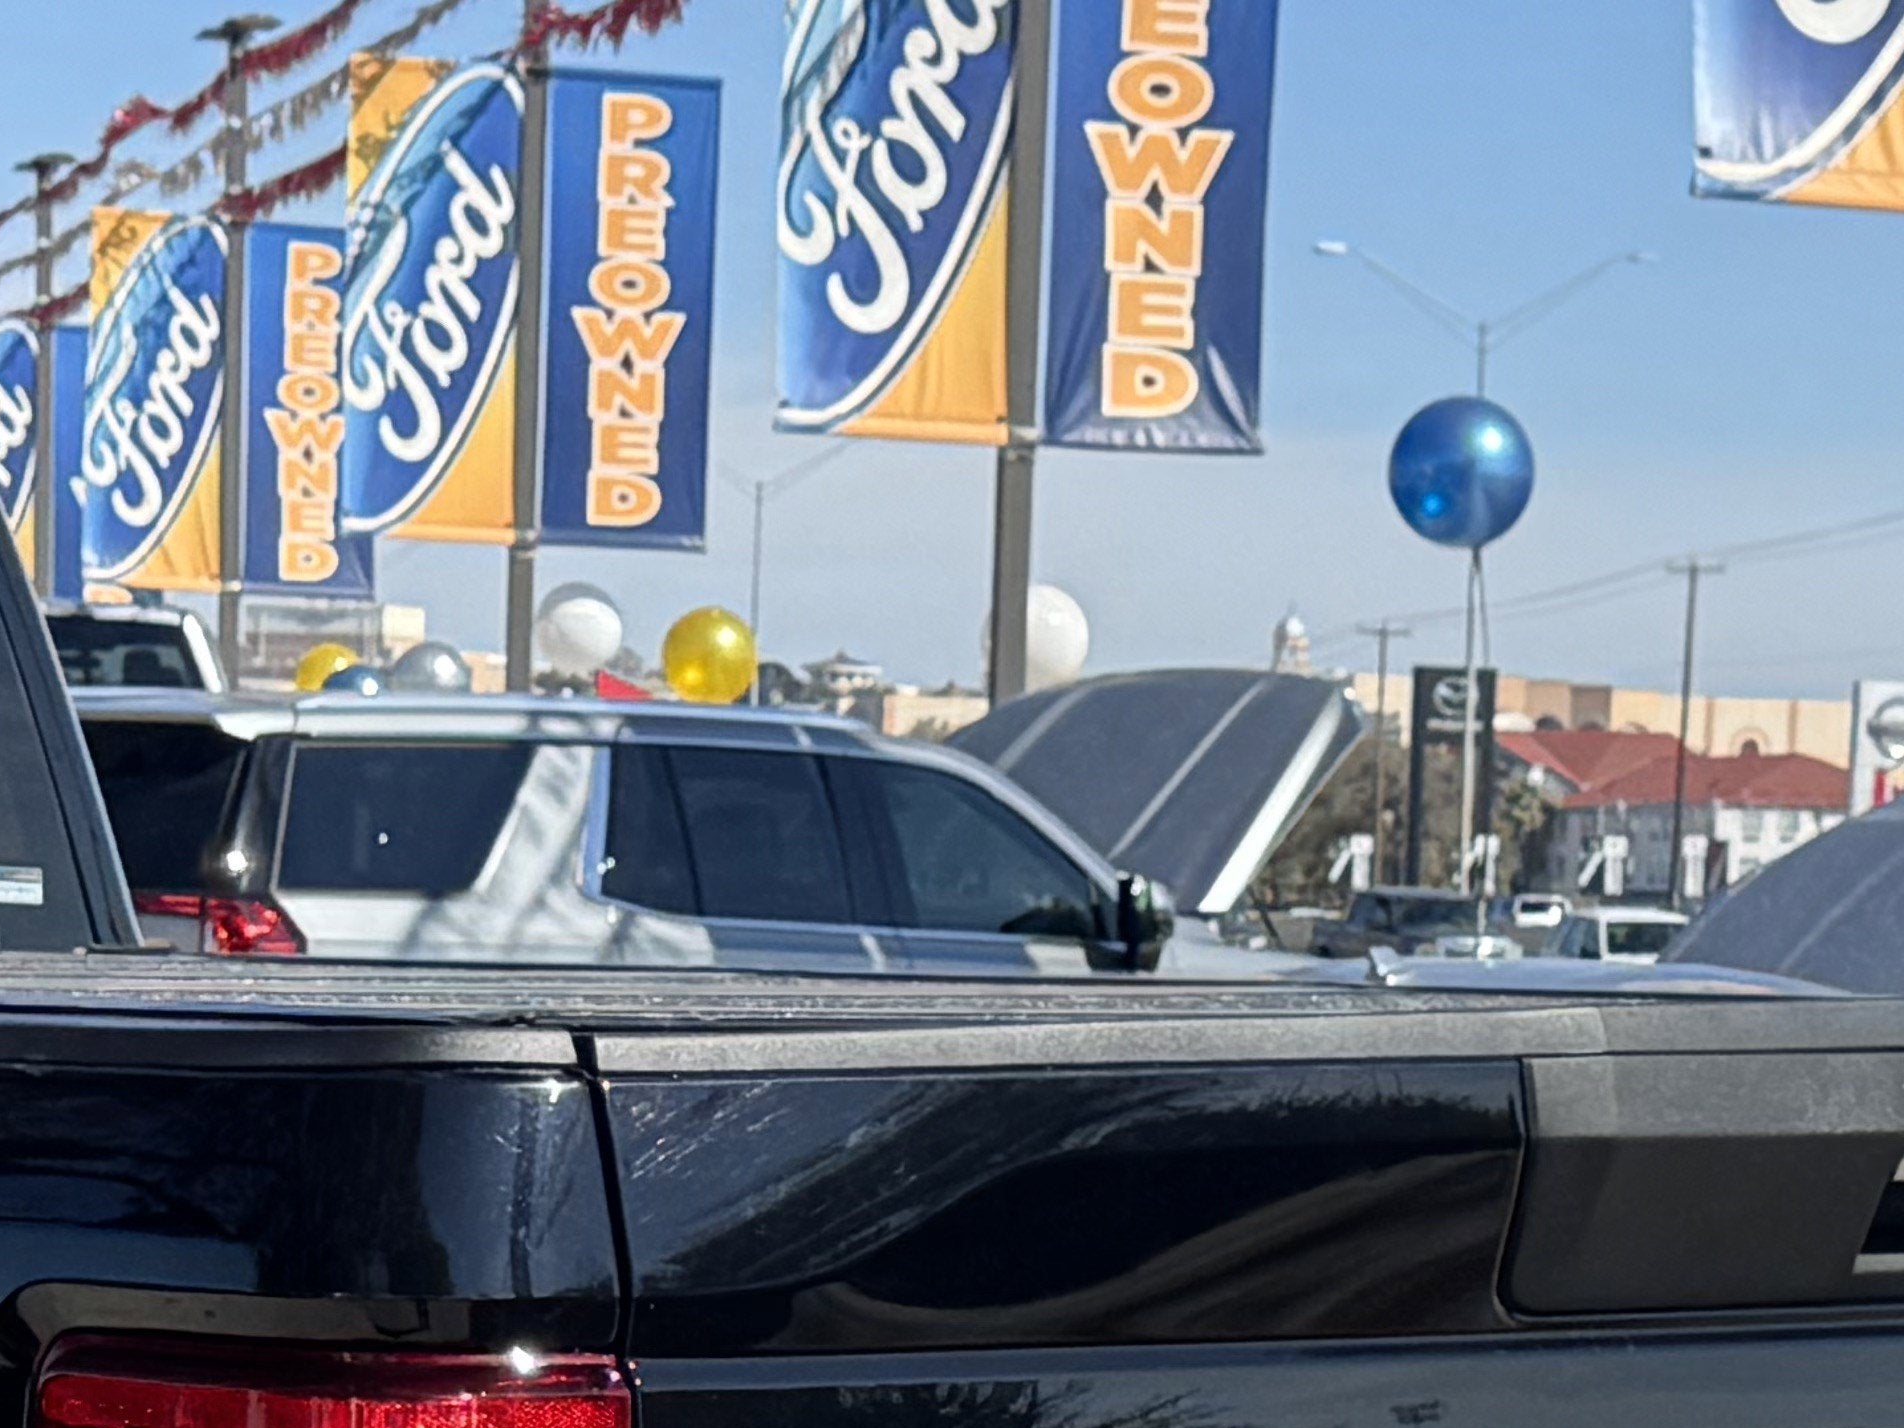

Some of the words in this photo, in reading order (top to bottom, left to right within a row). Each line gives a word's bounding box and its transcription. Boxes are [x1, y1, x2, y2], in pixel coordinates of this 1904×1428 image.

[81, 262, 222, 528] Ford
[263, 240, 345, 582] PREOWNED
[342, 139, 514, 464] Ford
[571, 92, 686, 527] PREOWNED
